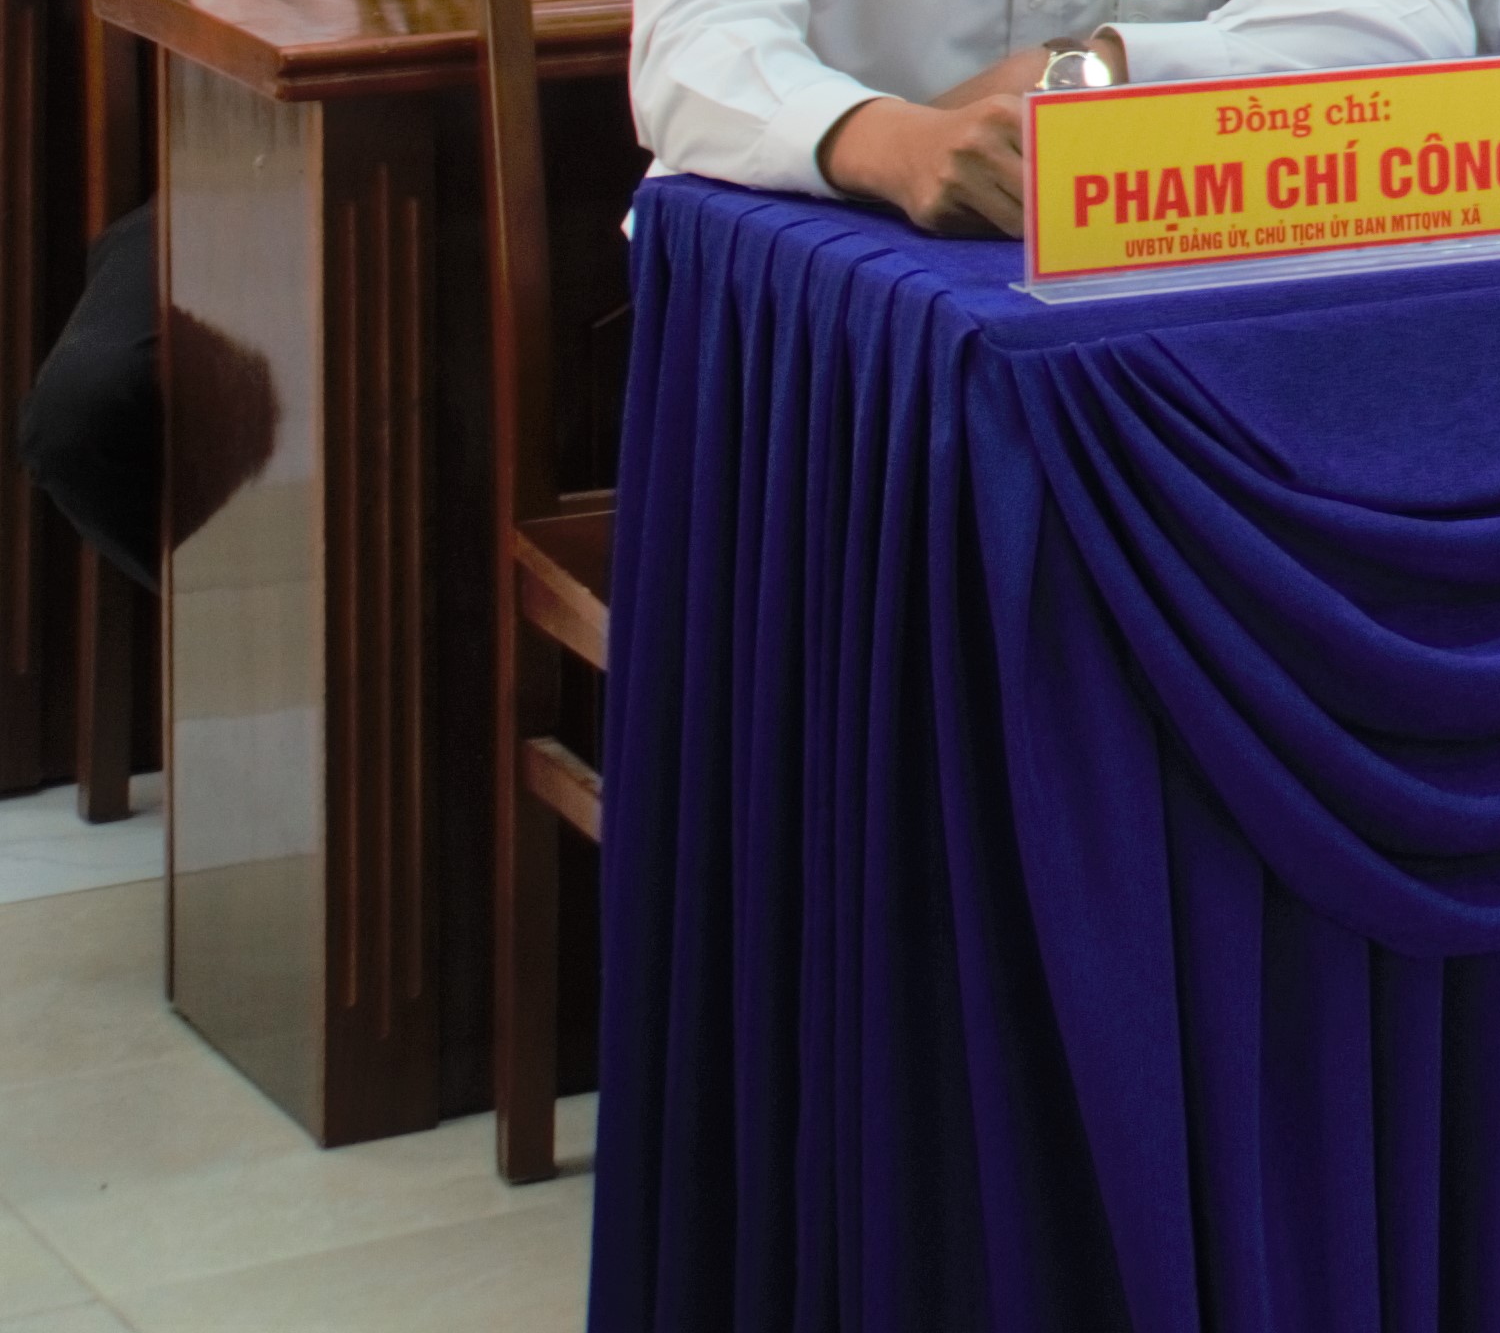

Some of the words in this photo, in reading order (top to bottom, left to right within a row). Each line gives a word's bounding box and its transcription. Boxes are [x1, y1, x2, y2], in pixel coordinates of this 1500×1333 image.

[1216, 96, 1312, 137] Đồng
[1325, 91, 1392, 125] chí:
[1074, 162, 1244, 232] PHẠM
[1266, 140, 1359, 210] CHÍ
[1125, 235, 1174, 259] UVBTV
[1179, 230, 1222, 253] ĐẢNG
[1228, 224, 1250, 249] ỦY,
[1255, 219, 1285, 246] CHỦ
[1291, 220, 1324, 246] TỊCH
[1330, 214, 1349, 238] ỦY
[1354, 216, 1385, 236] BAN
[1391, 210, 1451, 233] MTTQVN
[1461, 203, 1481, 227] XÃ
